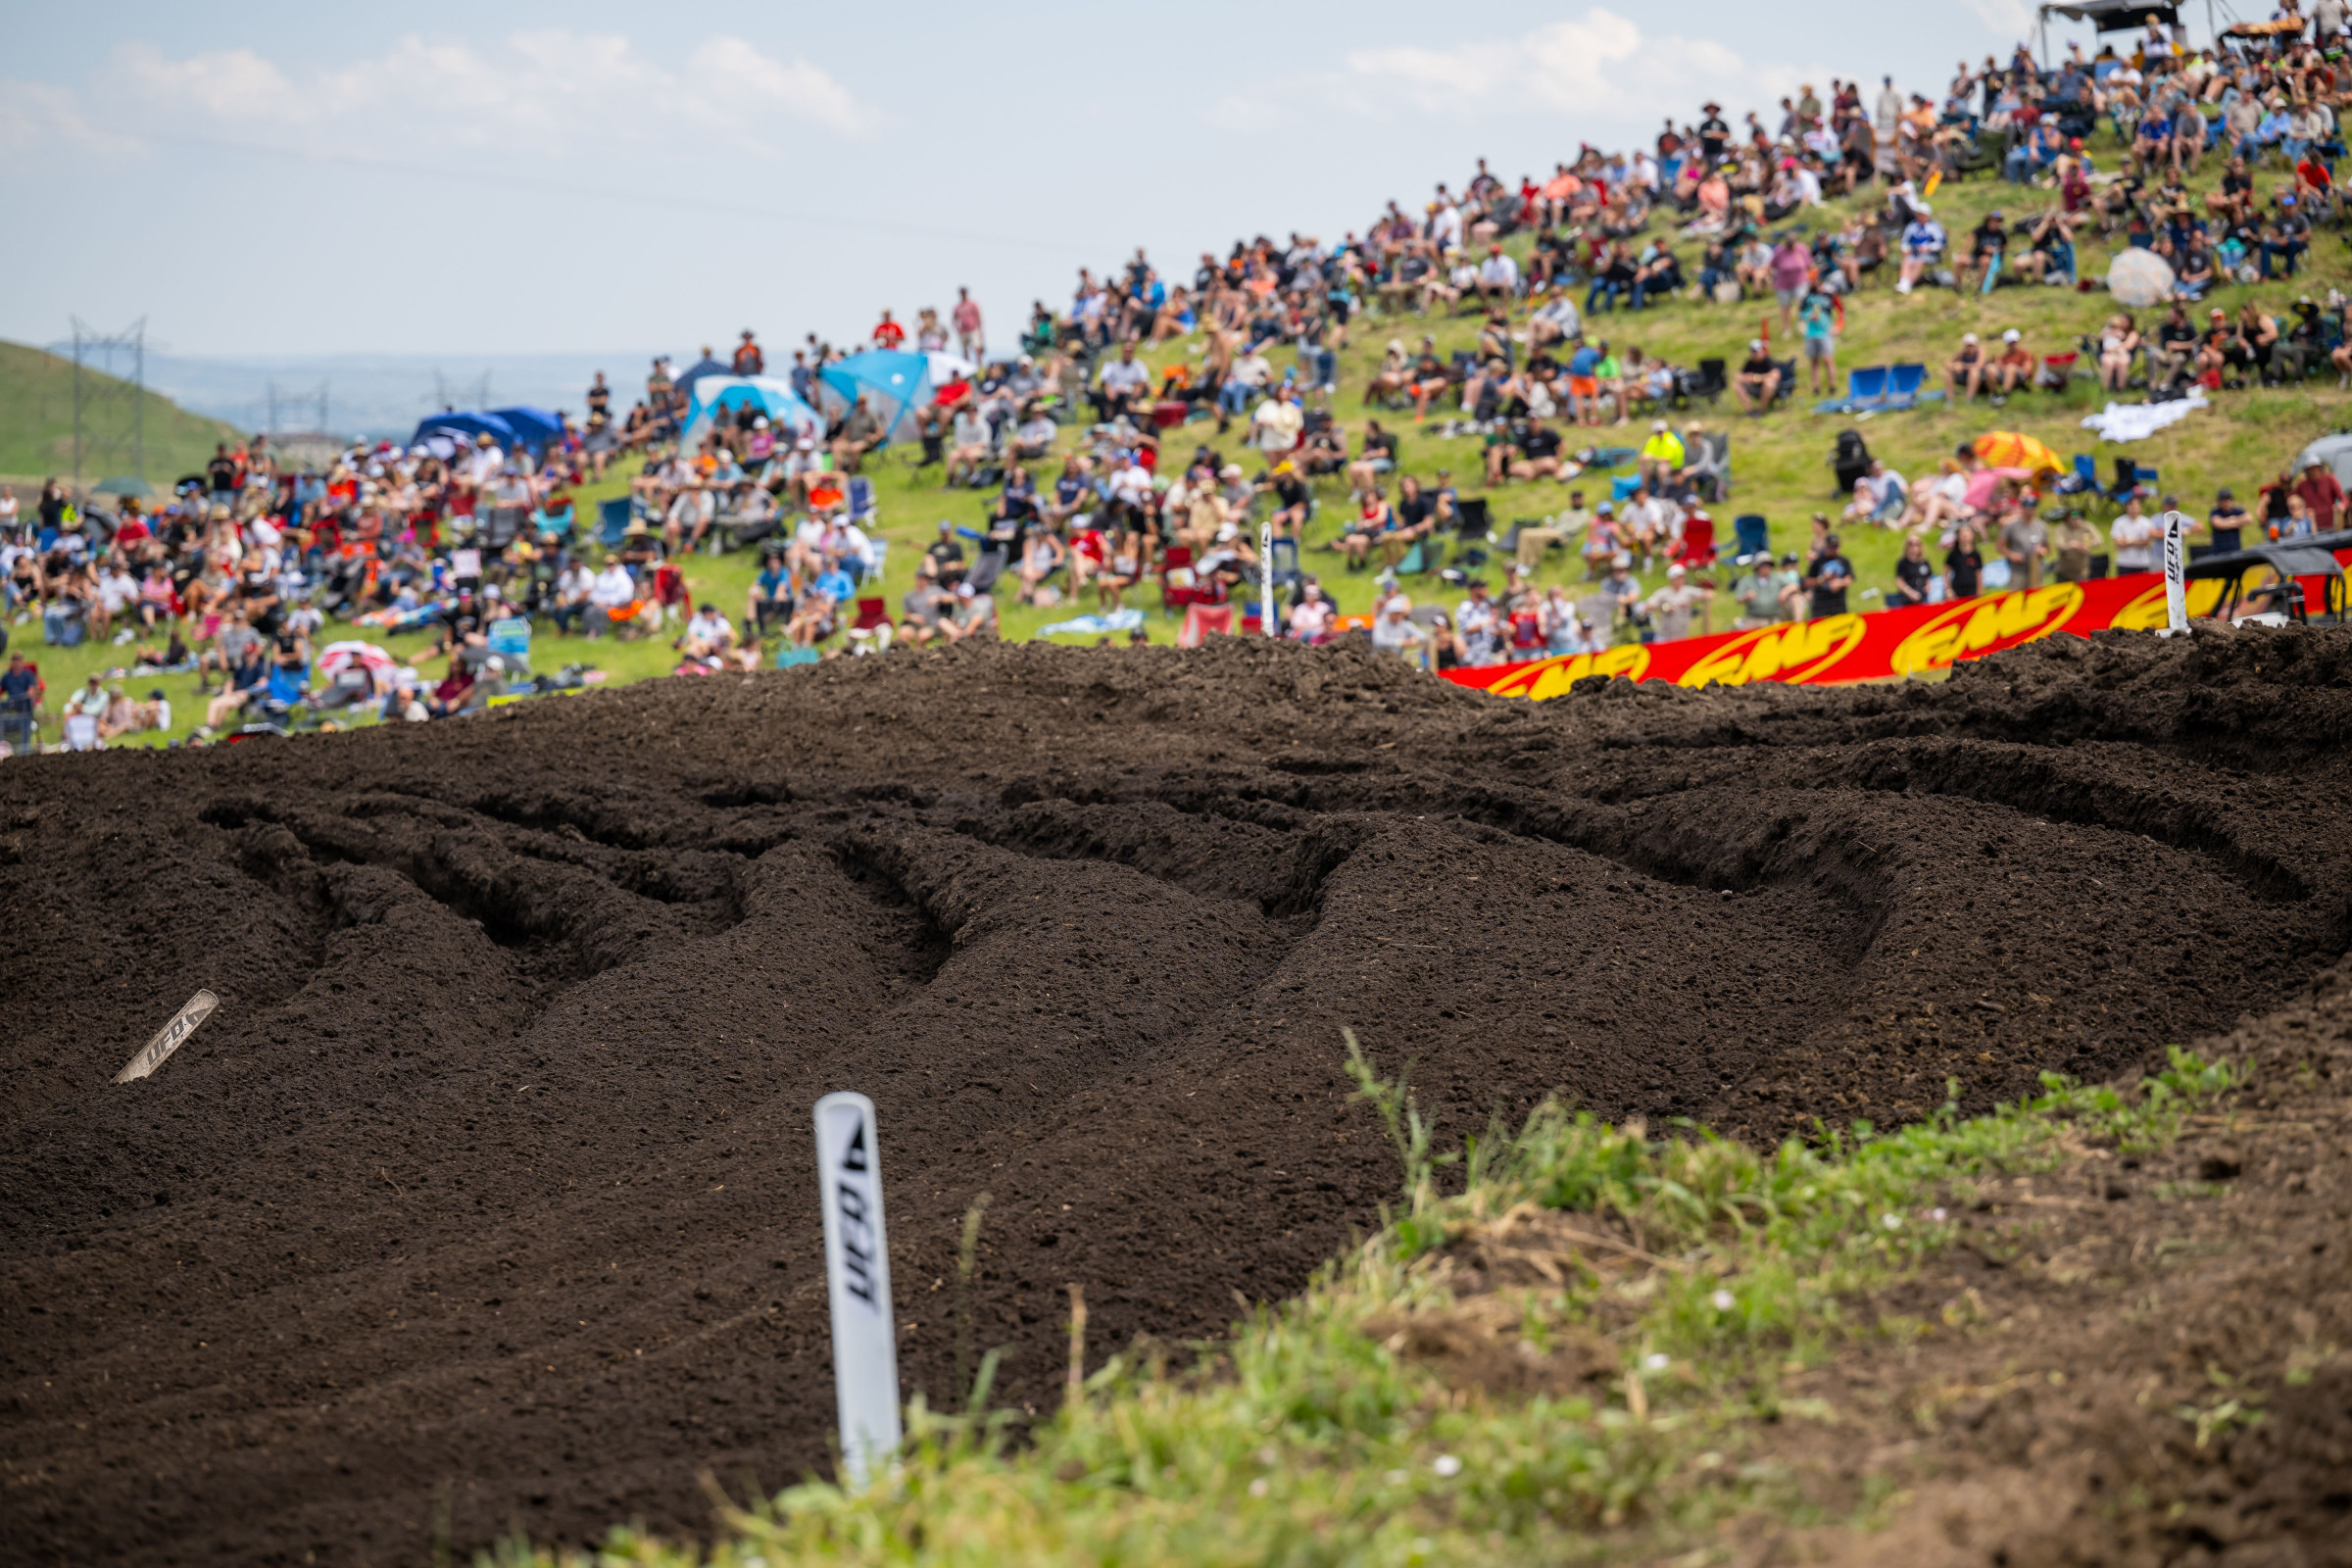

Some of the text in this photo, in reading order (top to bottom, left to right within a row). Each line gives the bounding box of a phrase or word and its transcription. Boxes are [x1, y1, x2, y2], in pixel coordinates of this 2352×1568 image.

[2166, 540, 2176, 582] UFO
[1895, 581, 2076, 676] FMF
[146, 1017, 185, 1066] UFO
[839, 1183, 873, 1303] UFO
